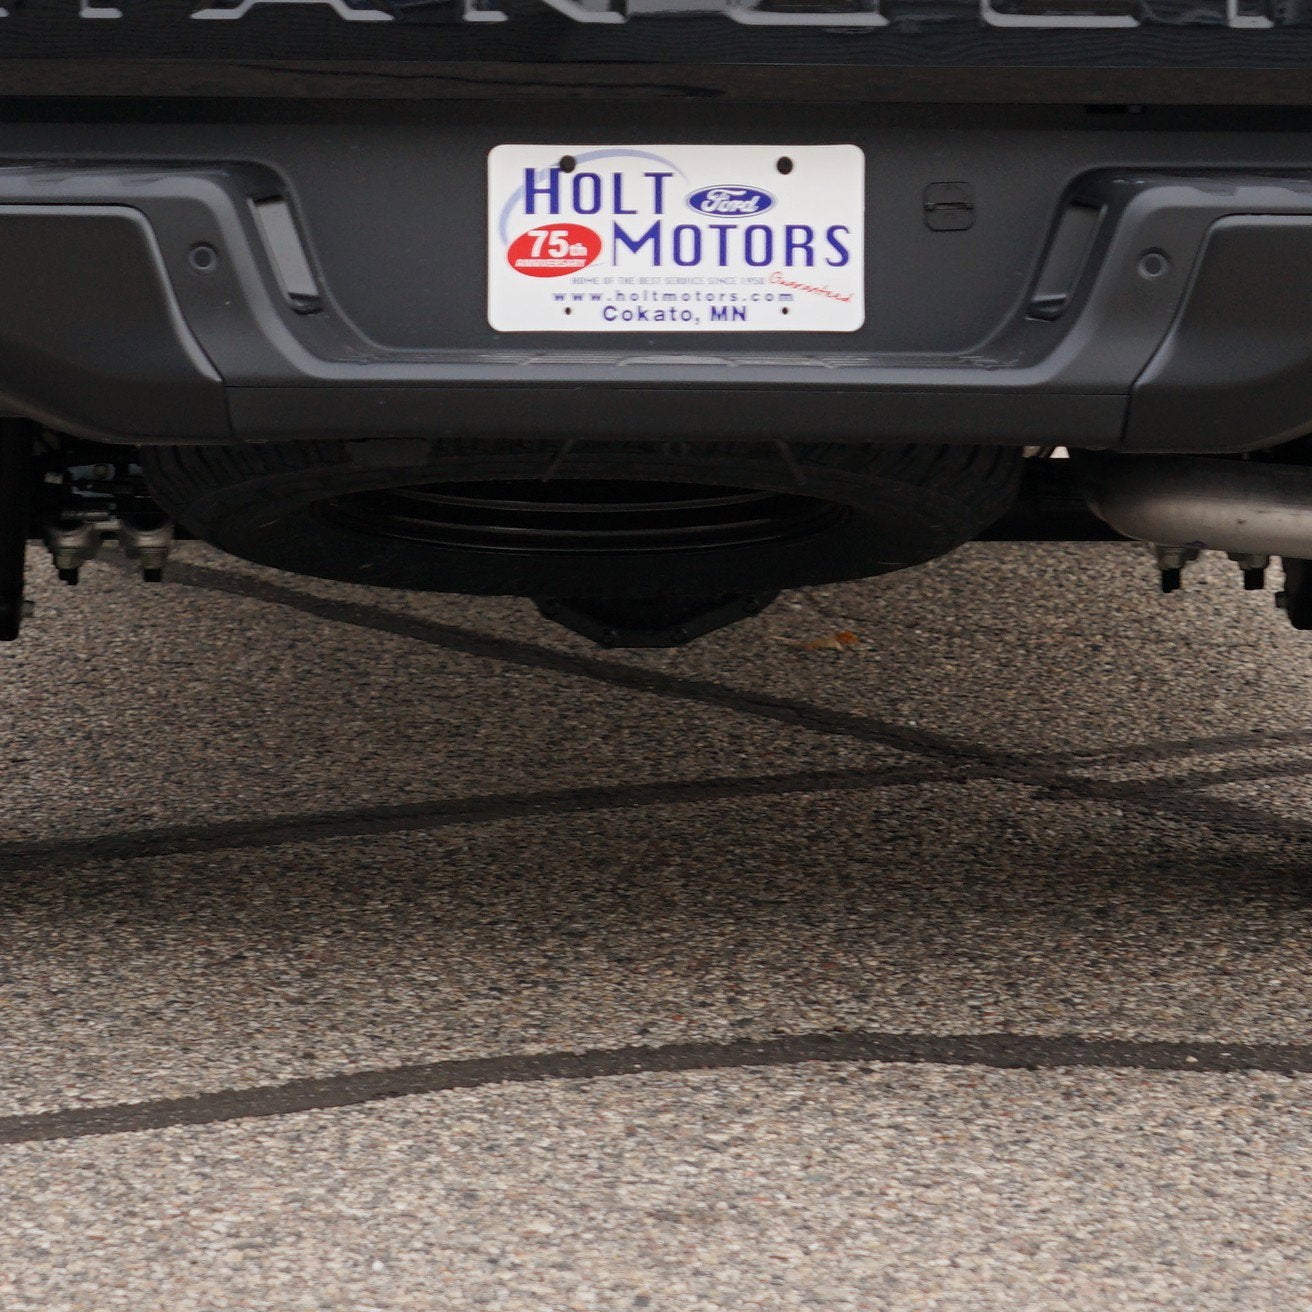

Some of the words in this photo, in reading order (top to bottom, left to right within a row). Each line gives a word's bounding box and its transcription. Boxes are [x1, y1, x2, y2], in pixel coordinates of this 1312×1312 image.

[525, 168, 673, 214] HOLT
[700, 189, 760, 214] Ford
[613, 220, 850, 266] MOTORS
[552, 290, 794, 302] www.holtmotors.com
[603, 305, 700, 325] Cokato,
[710, 305, 747, 322] MN
